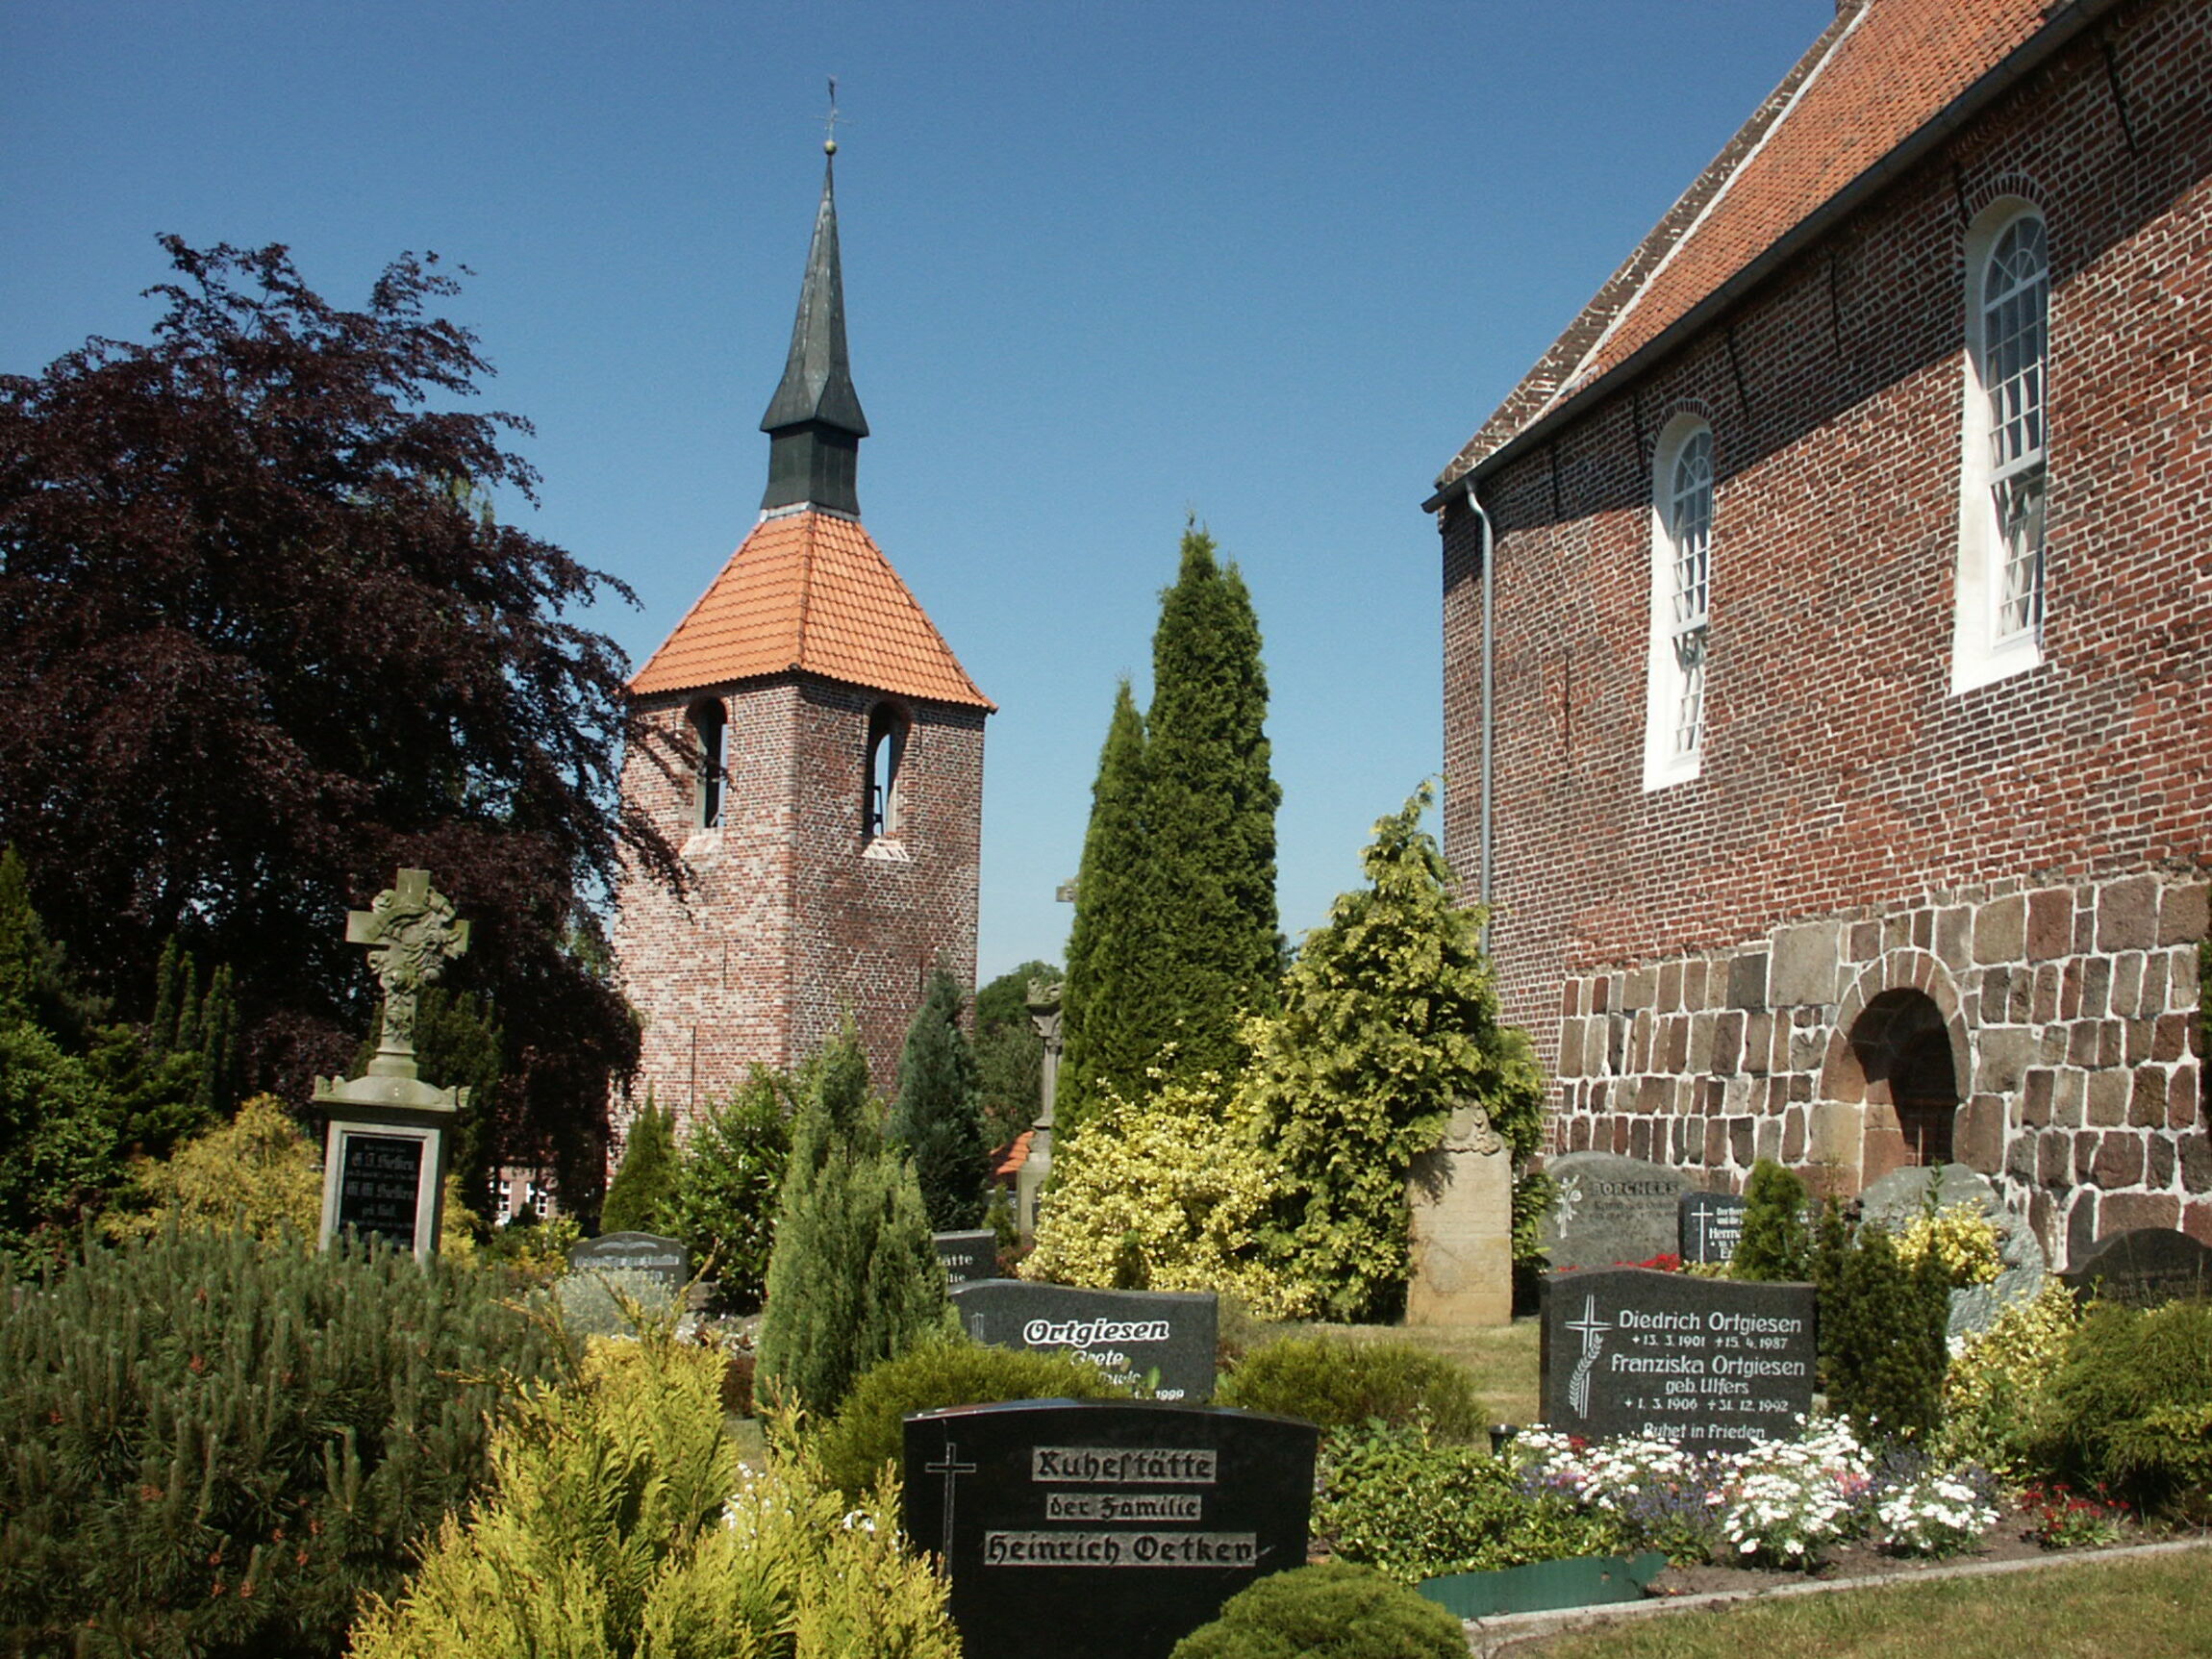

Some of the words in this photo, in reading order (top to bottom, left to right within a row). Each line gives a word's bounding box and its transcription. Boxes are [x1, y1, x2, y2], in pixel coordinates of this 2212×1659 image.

[1591, 1181, 1678, 1195] BORCHERS
[1022, 1318, 1170, 1348] Ortgiesen
[1619, 1310, 1700, 1330] Diedrich
[1708, 1312, 1802, 1336] Ortgiesen
[1611, 1353, 1705, 1373] Franziska
[1712, 1355, 1806, 1378] Ortgiesen
[1665, 1378, 1697, 1395] geb.
[1700, 1378, 1749, 1395] Ulfers
[1691, 1423, 1704, 1439] in
[1708, 1423, 1766, 1440] Frieden
[1049, 1496, 1090, 1517] der
[1099, 1496, 1198, 1521] Familie
[988, 1534, 1120, 1565] Heinrich
[1132, 1535, 1254, 1562] Oetken
